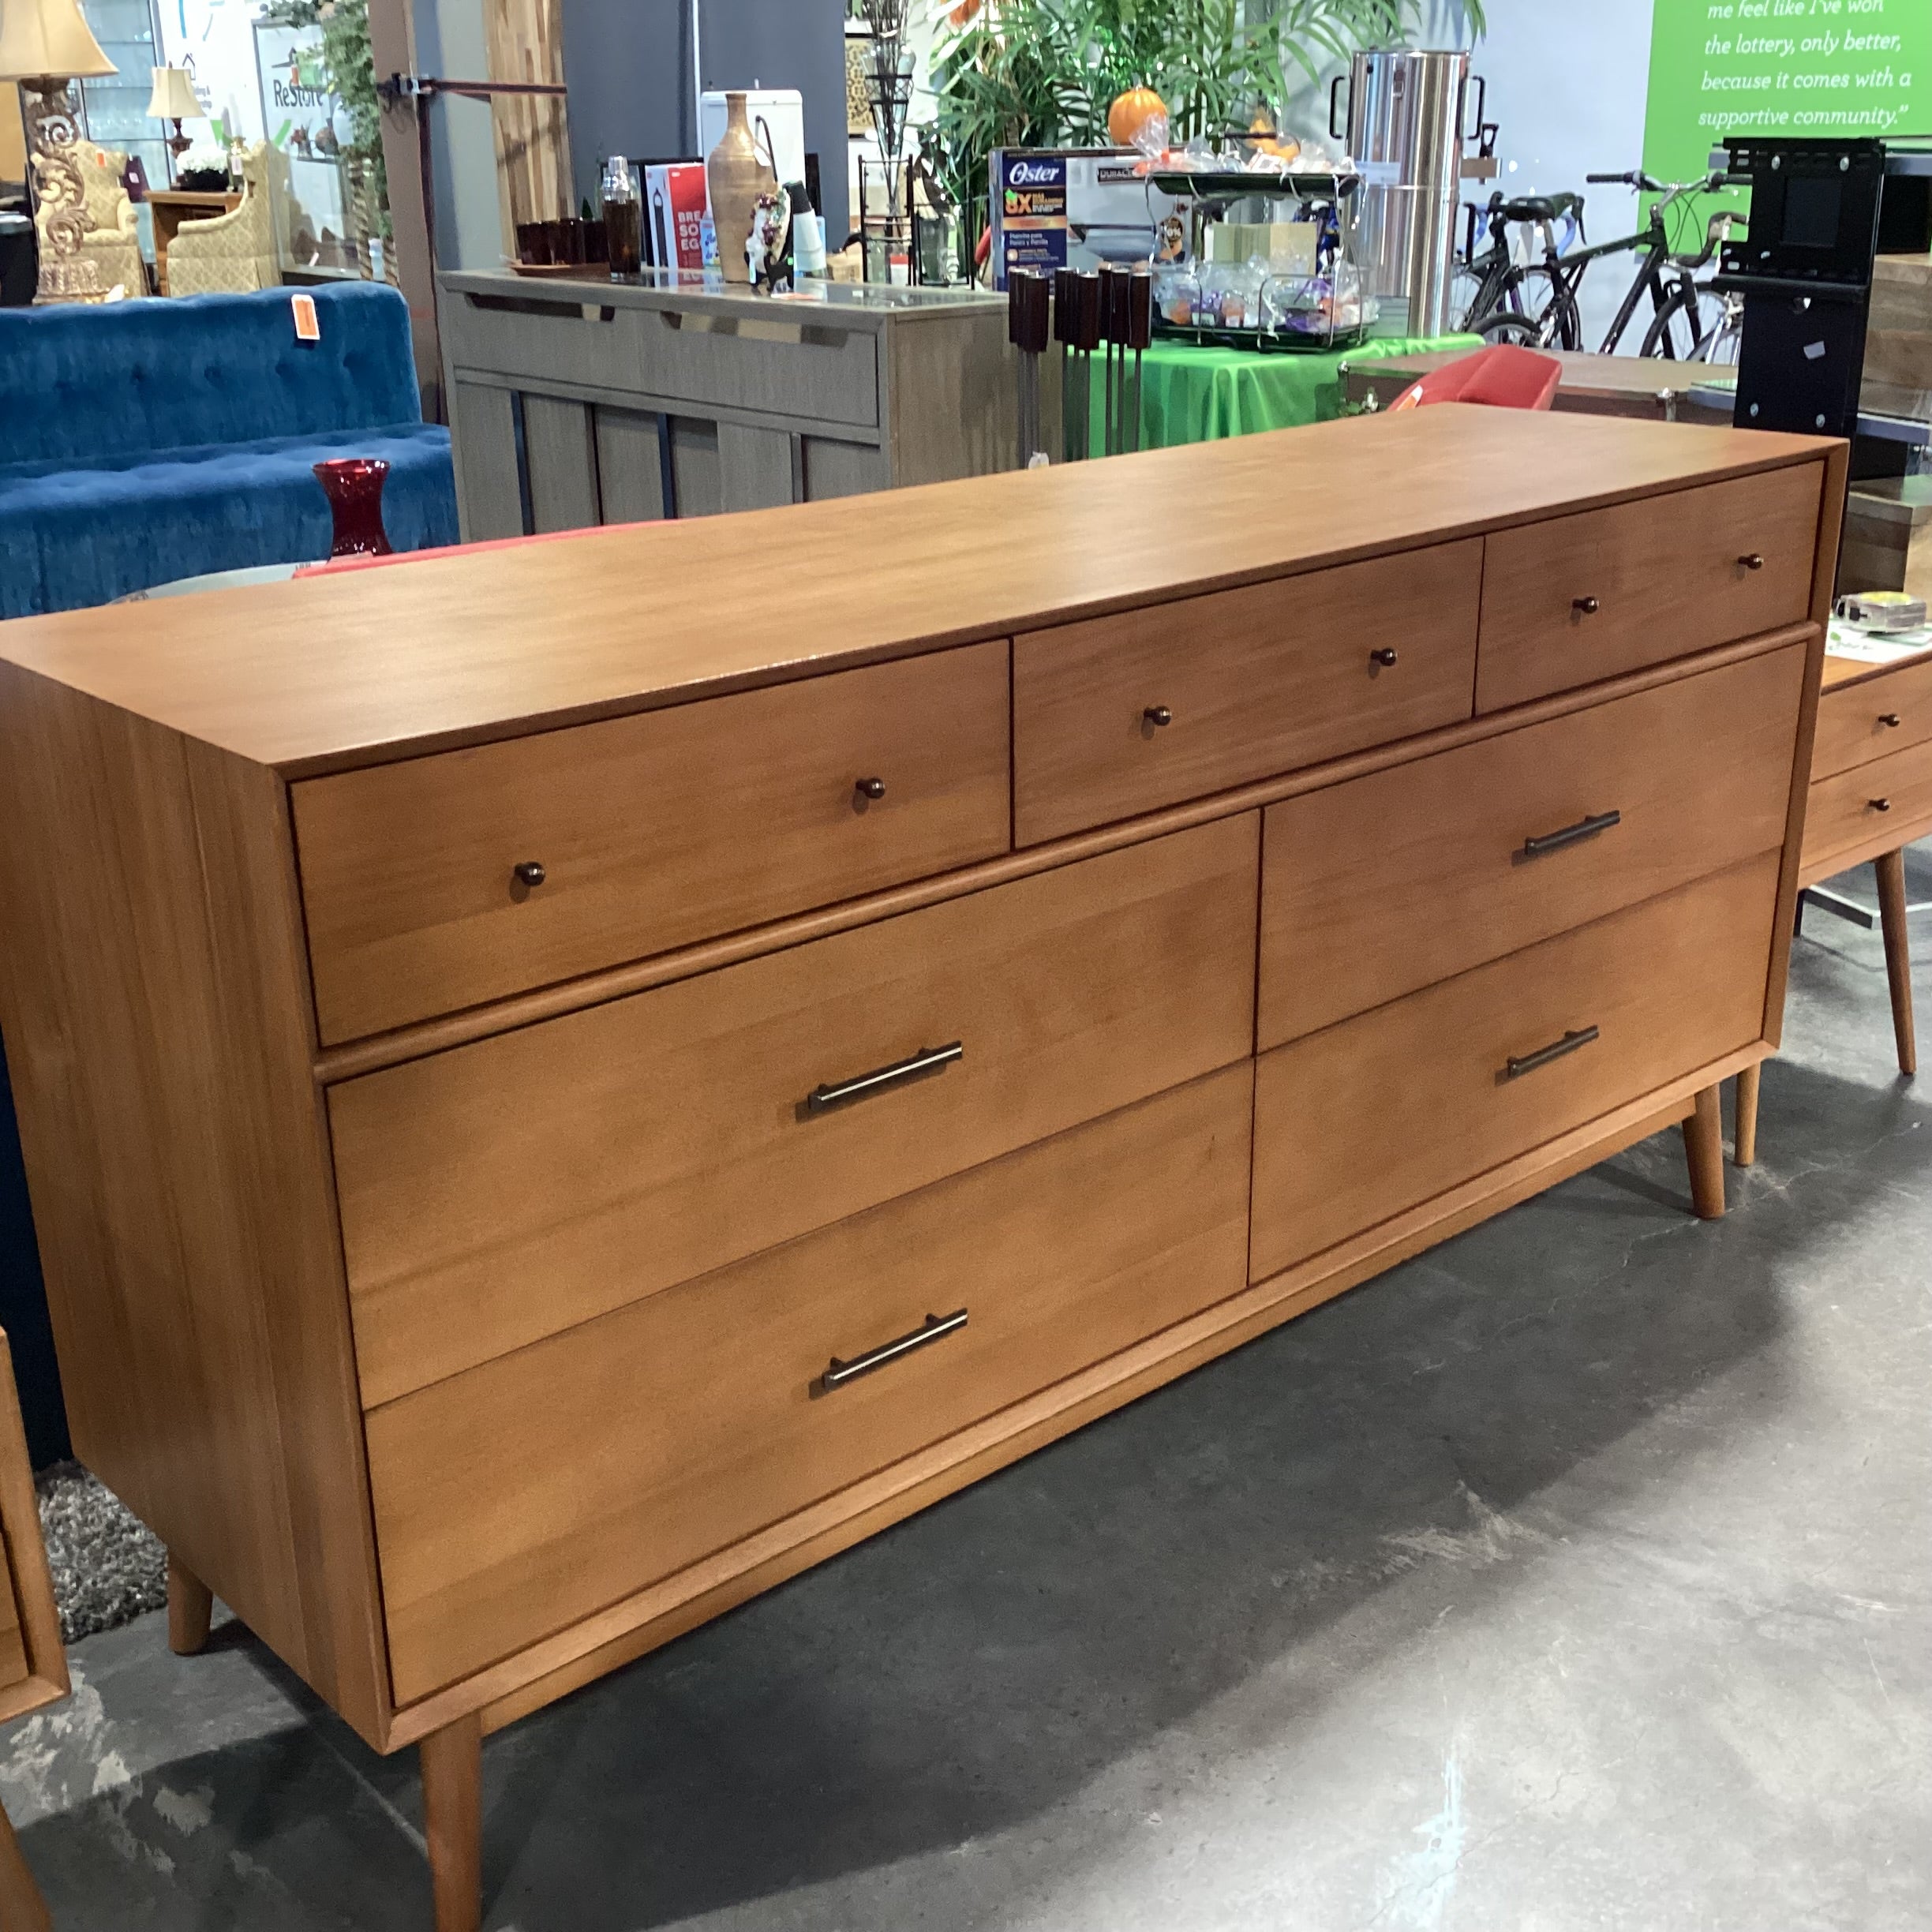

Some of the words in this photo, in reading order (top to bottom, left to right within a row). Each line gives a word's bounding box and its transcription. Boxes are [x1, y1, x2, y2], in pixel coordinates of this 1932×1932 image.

[1707, 5, 1733, 19] me
[1738, 0, 1769, 17] feel
[1773, 0, 1805, 16] like
[1809, 0, 1841, 15] I've
[1848, 0, 1884, 13] won
[1705, 34, 1732, 54] the
[1735, 32, 1795, 57] lottery,
[1800, 29, 1840, 57] only
[1844, 28, 1901, 52] better,
[1701, 69, 1772, 91] because
[1776, 71, 1789, 89] it
[1793, 73, 1850, 88] comes
[1855, 65, 1894, 88] with
[1899, 73, 1912, 87] a
[1698, 107, 1789, 130] supportive
[1009, 161, 1060, 185] Oster
